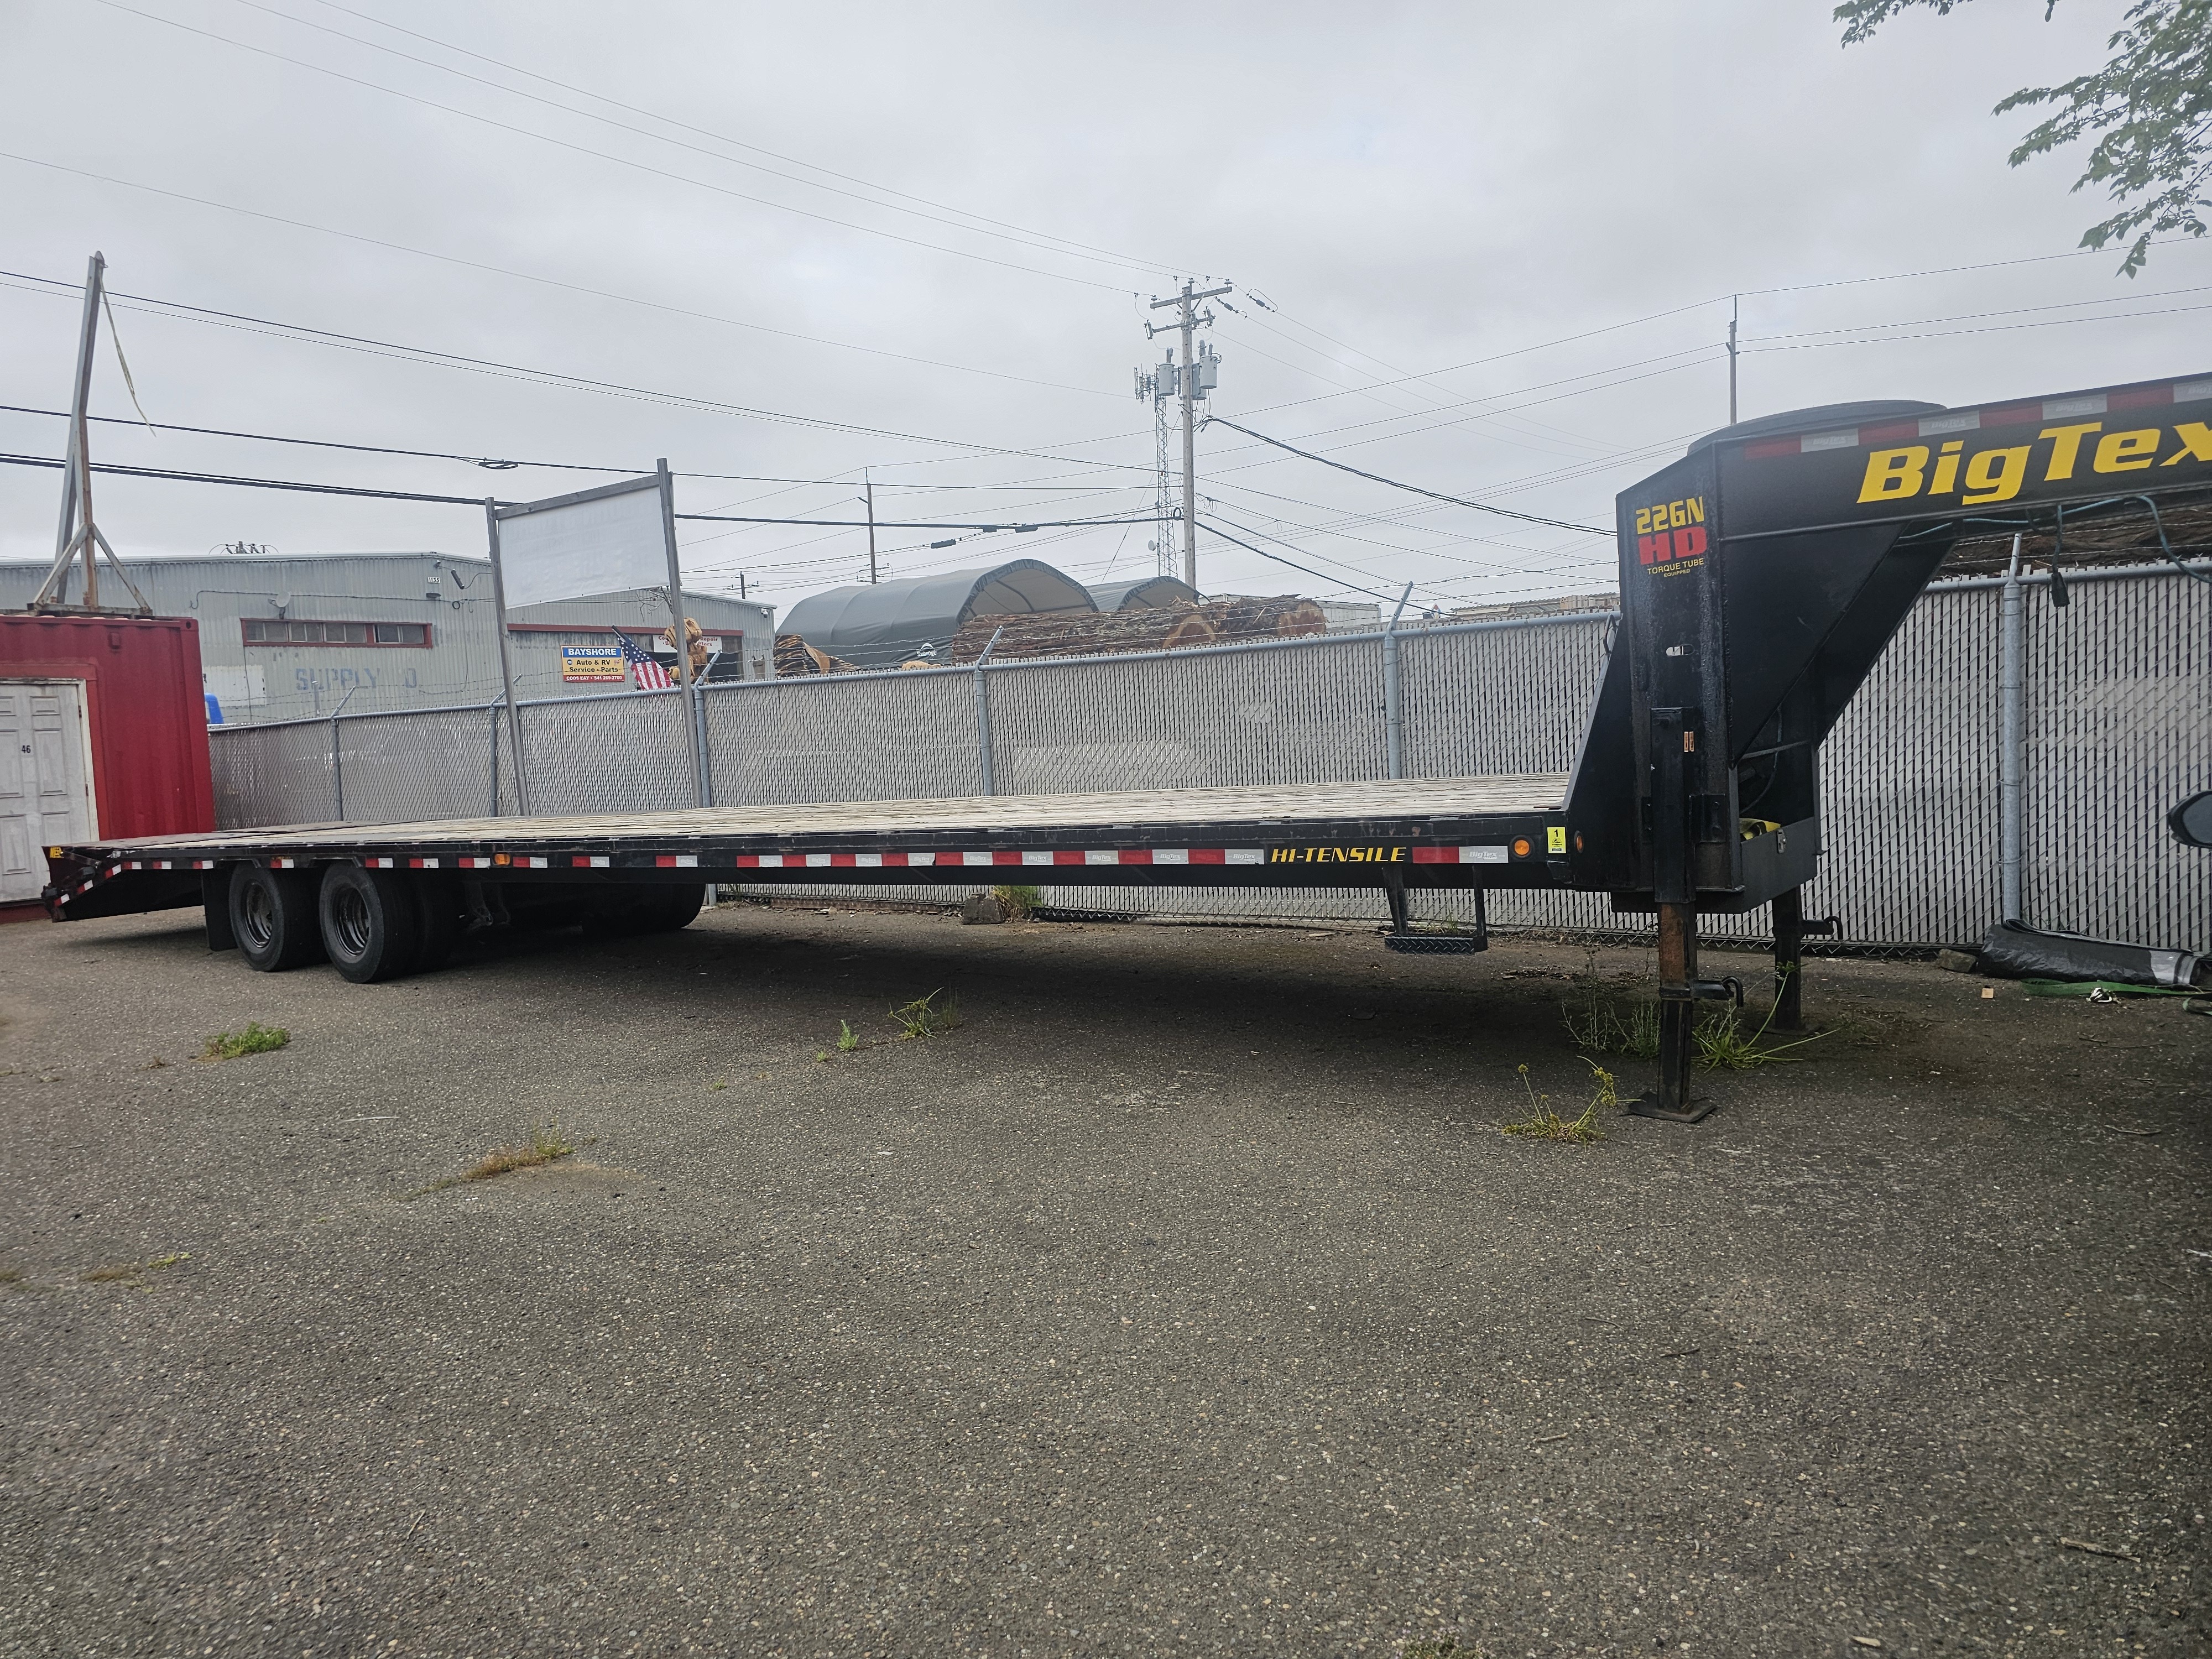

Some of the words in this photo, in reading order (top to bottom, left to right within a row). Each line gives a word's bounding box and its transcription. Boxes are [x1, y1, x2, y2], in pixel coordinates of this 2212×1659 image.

[1856, 421, 2212, 505] BigTex
[1636, 496, 1704, 534] 22GN
[1639, 526, 1707, 565] HD
[1647, 562, 1681, 575] TORQUE
[1682, 558, 1704, 569] TUBE
[1663, 569, 1691, 578] EQUIPPED
[295, 667, 380, 690] SUPPLY
[22, 745, 31, 753] 46
[1554, 829, 1558, 837] 1
[1271, 847, 1407, 862] HI-TENSILE
